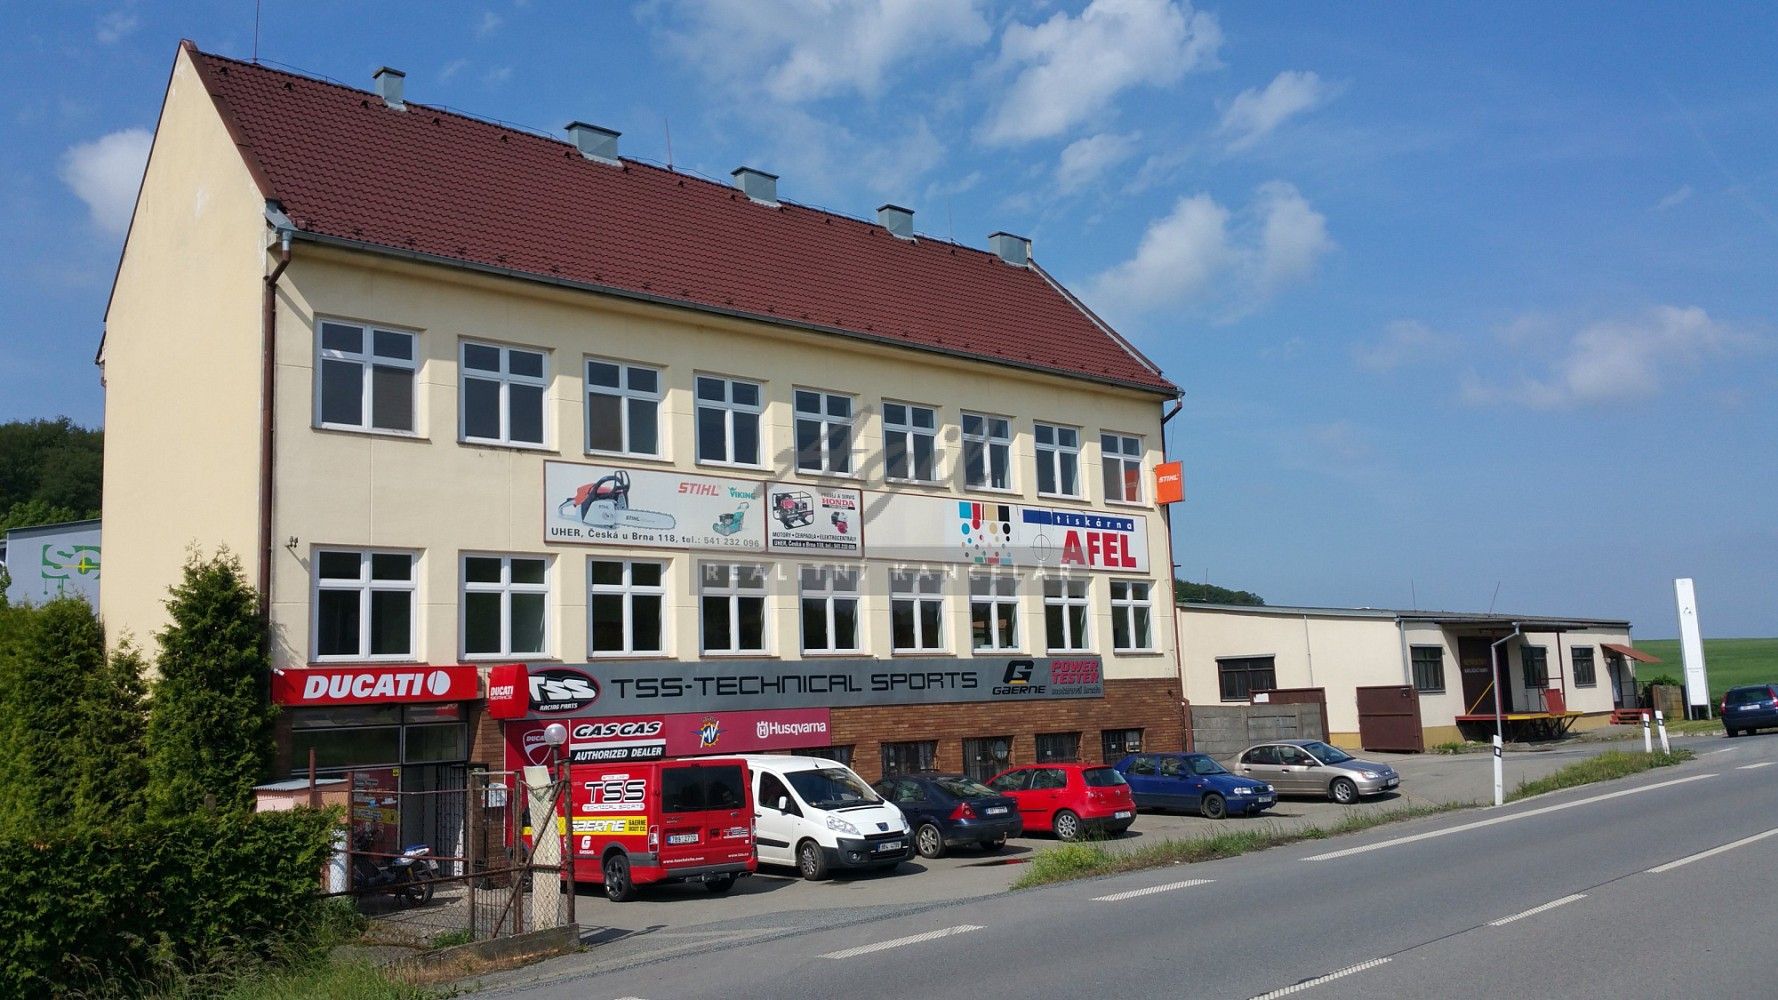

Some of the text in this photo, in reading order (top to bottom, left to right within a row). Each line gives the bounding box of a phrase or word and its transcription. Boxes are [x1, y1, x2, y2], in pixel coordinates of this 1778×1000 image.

[1158, 474, 1178, 483] STIHL
[678, 482, 719, 497] STIHL
[729, 490, 756, 500] VIKING
[822, 498, 855, 507] HONDA
[1056, 514, 1133, 530] tiskárna
[551, 527, 584, 538] UHER,
[588, 528, 618, 540] Česká
[622, 532, 628, 540] u
[632, 532, 654, 541] Brna
[658, 534, 678, 544] 118,
[703, 536, 720, 545] 541
[724, 538, 740, 546] 232
[743, 538, 760, 548] 096
[1060, 530, 1137, 568] AFEL
[1051, 660, 1099, 672] POWER
[303, 673, 424, 699] DUCATI
[611, 672, 978, 699] TSS-TECHNICAL SPORTS
[1052, 672, 1100, 685] TESTER
[490, 685, 514, 696] DUCATI
[528, 676, 596, 702] TSS
[769, 721, 827, 736] Husqvarna
[575, 747, 662, 761] AUTHORIZED DEALER
[585, 780, 646, 803] TSS
